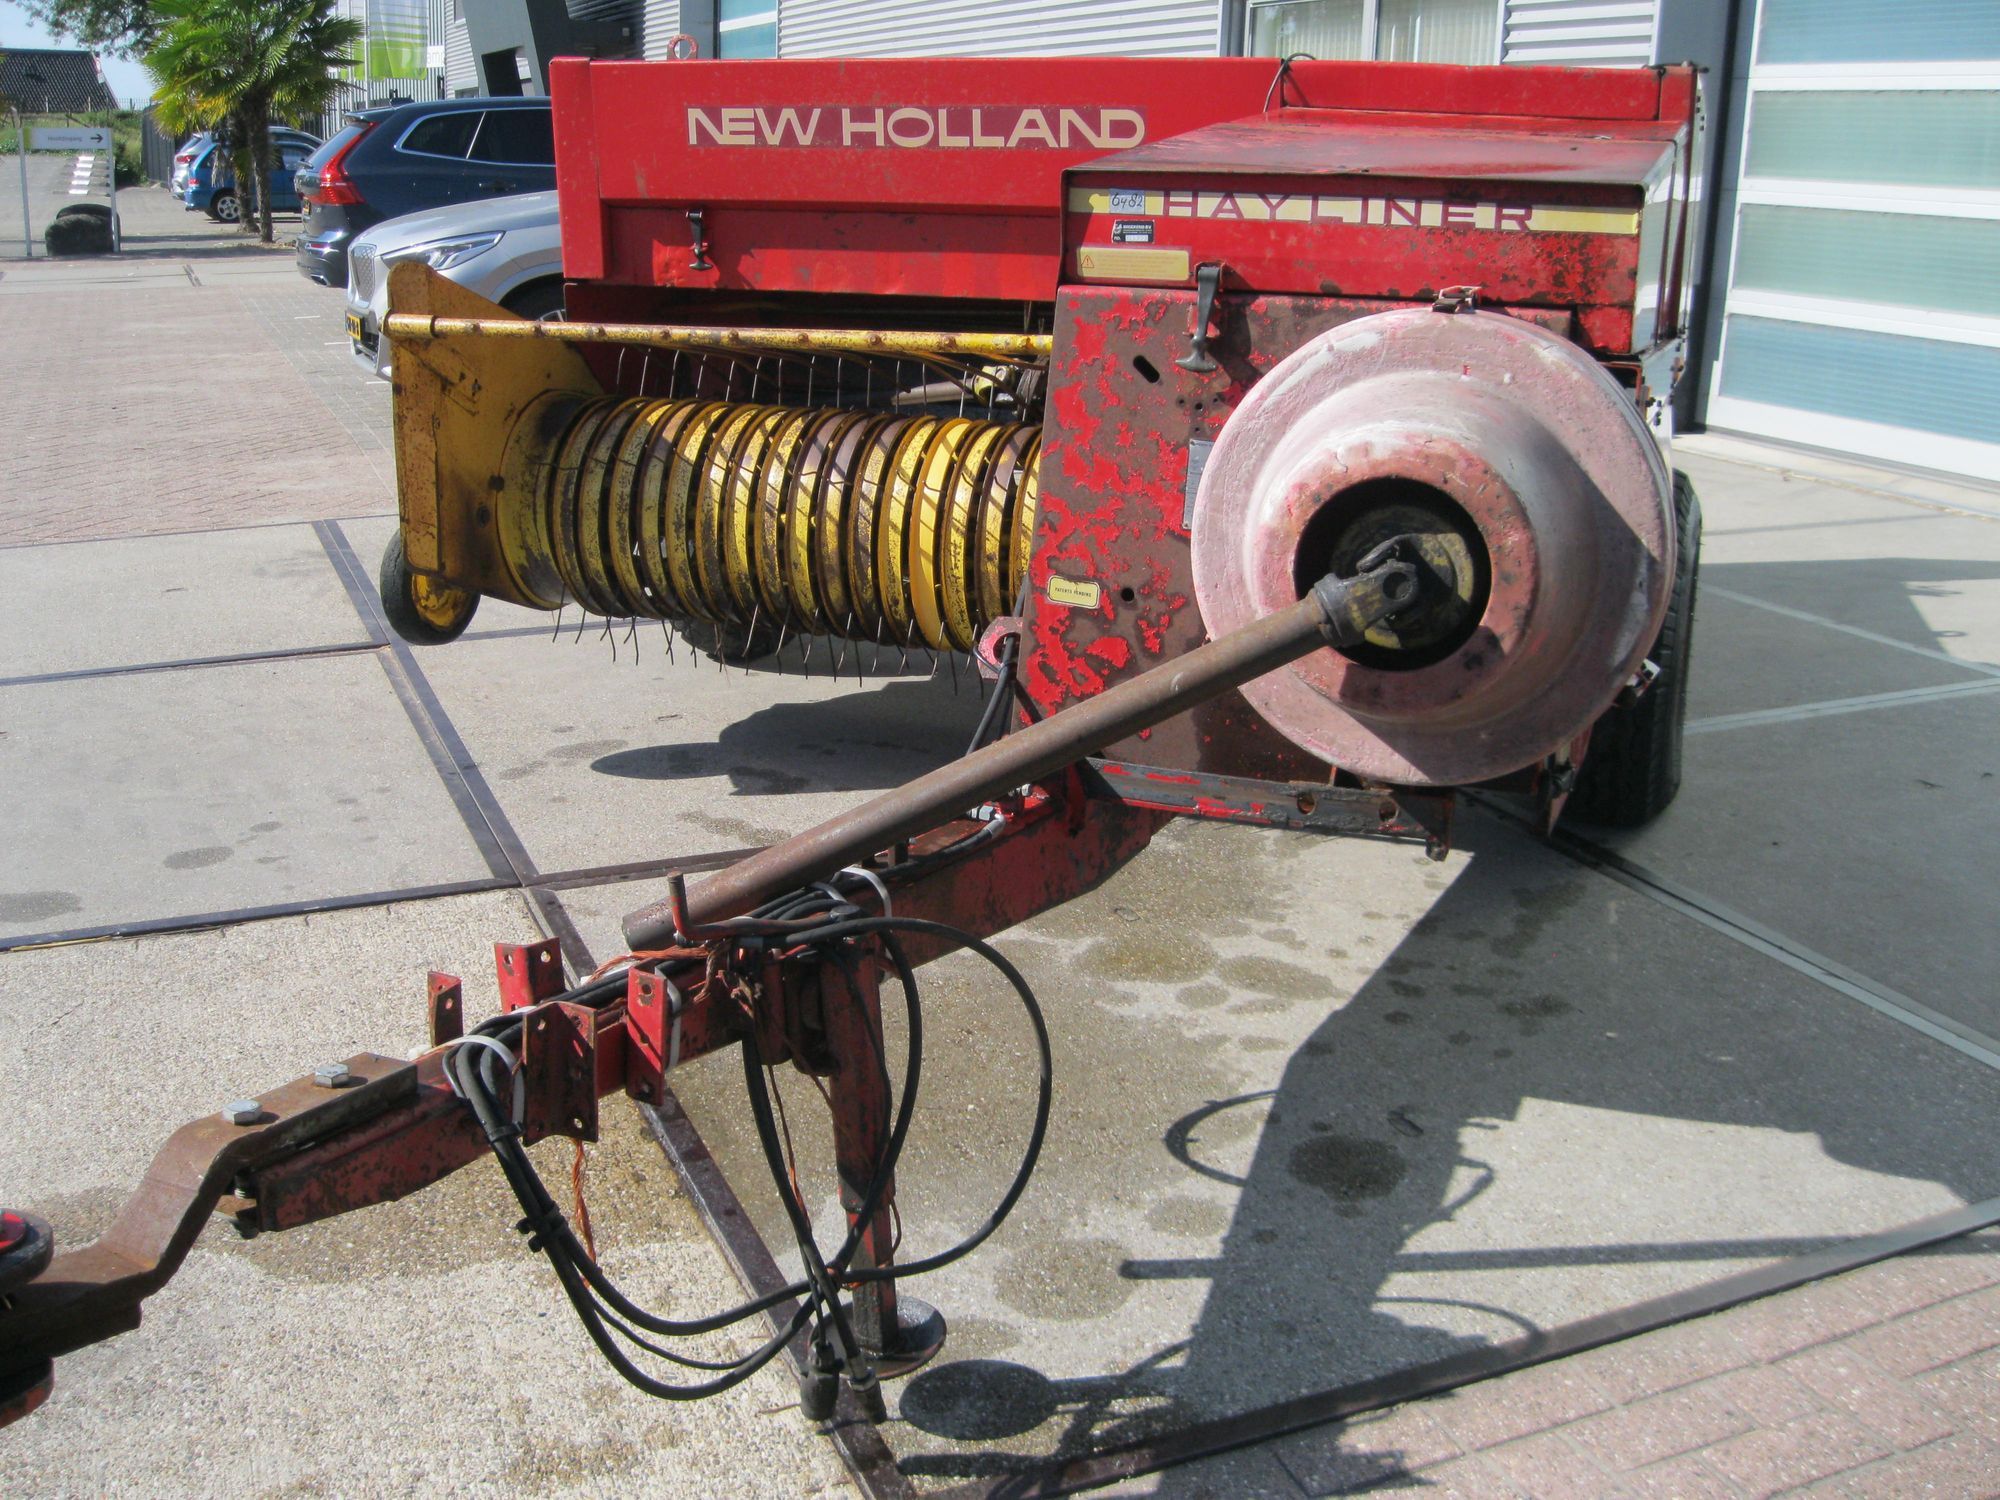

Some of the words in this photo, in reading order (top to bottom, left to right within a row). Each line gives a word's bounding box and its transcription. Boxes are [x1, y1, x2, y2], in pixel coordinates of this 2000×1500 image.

[688, 108, 821, 145] NEW
[842, 107, 1146, 148] HOLLAND
[1112, 192, 1143, 209] 6482
[1163, 190, 1532, 232] HAYLINER
